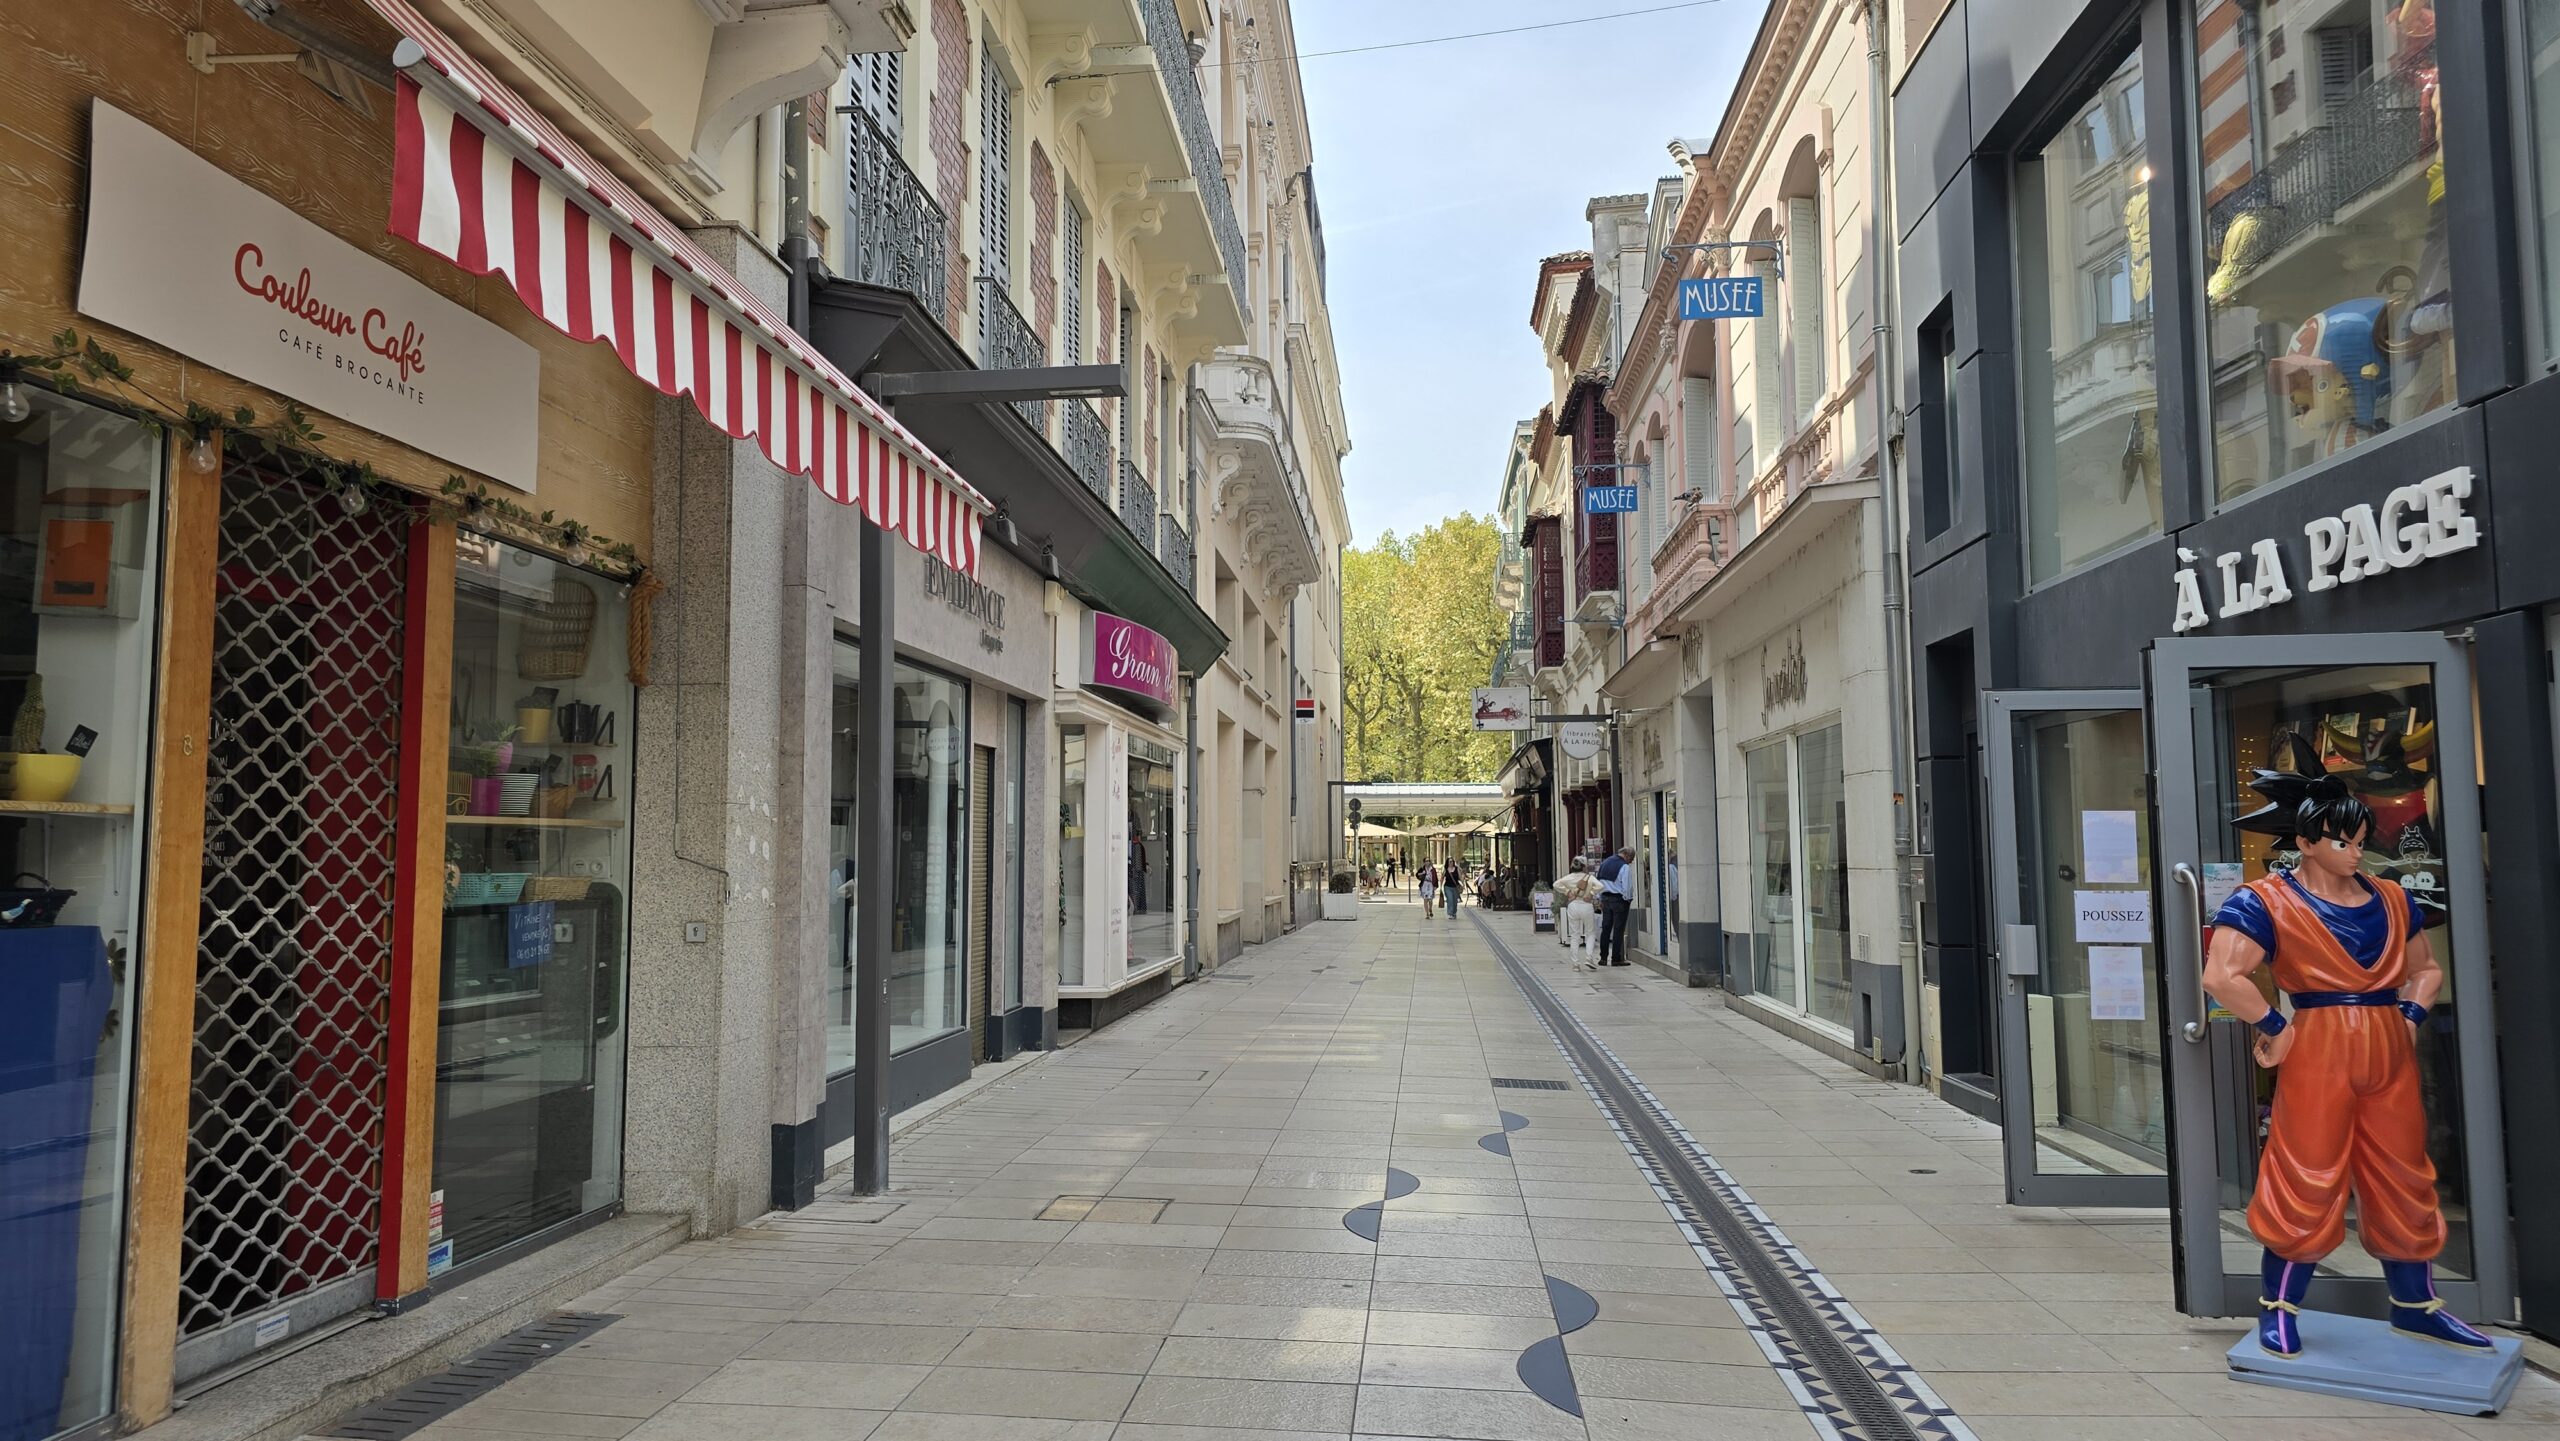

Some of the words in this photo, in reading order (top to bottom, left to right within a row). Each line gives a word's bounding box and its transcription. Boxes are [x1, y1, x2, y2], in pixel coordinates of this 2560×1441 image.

[234, 242, 356, 337] Couleur
[362, 308, 425, 382] Café
[1684, 281, 1757, 316] MUSEE
[279, 328, 323, 360] CAFÉ
[335, 354, 425, 404] BROCANTE
[1588, 489, 1635, 511] MUSEE
[2172, 547, 2209, 632] À
[2216, 538, 2292, 619] LA
[2304, 466, 2478, 592] PAGE
[926, 554, 1006, 631] EVIDENCE
[1109, 625, 1161, 687] Grain
[2082, 910, 2144, 922] POUSSEZ
